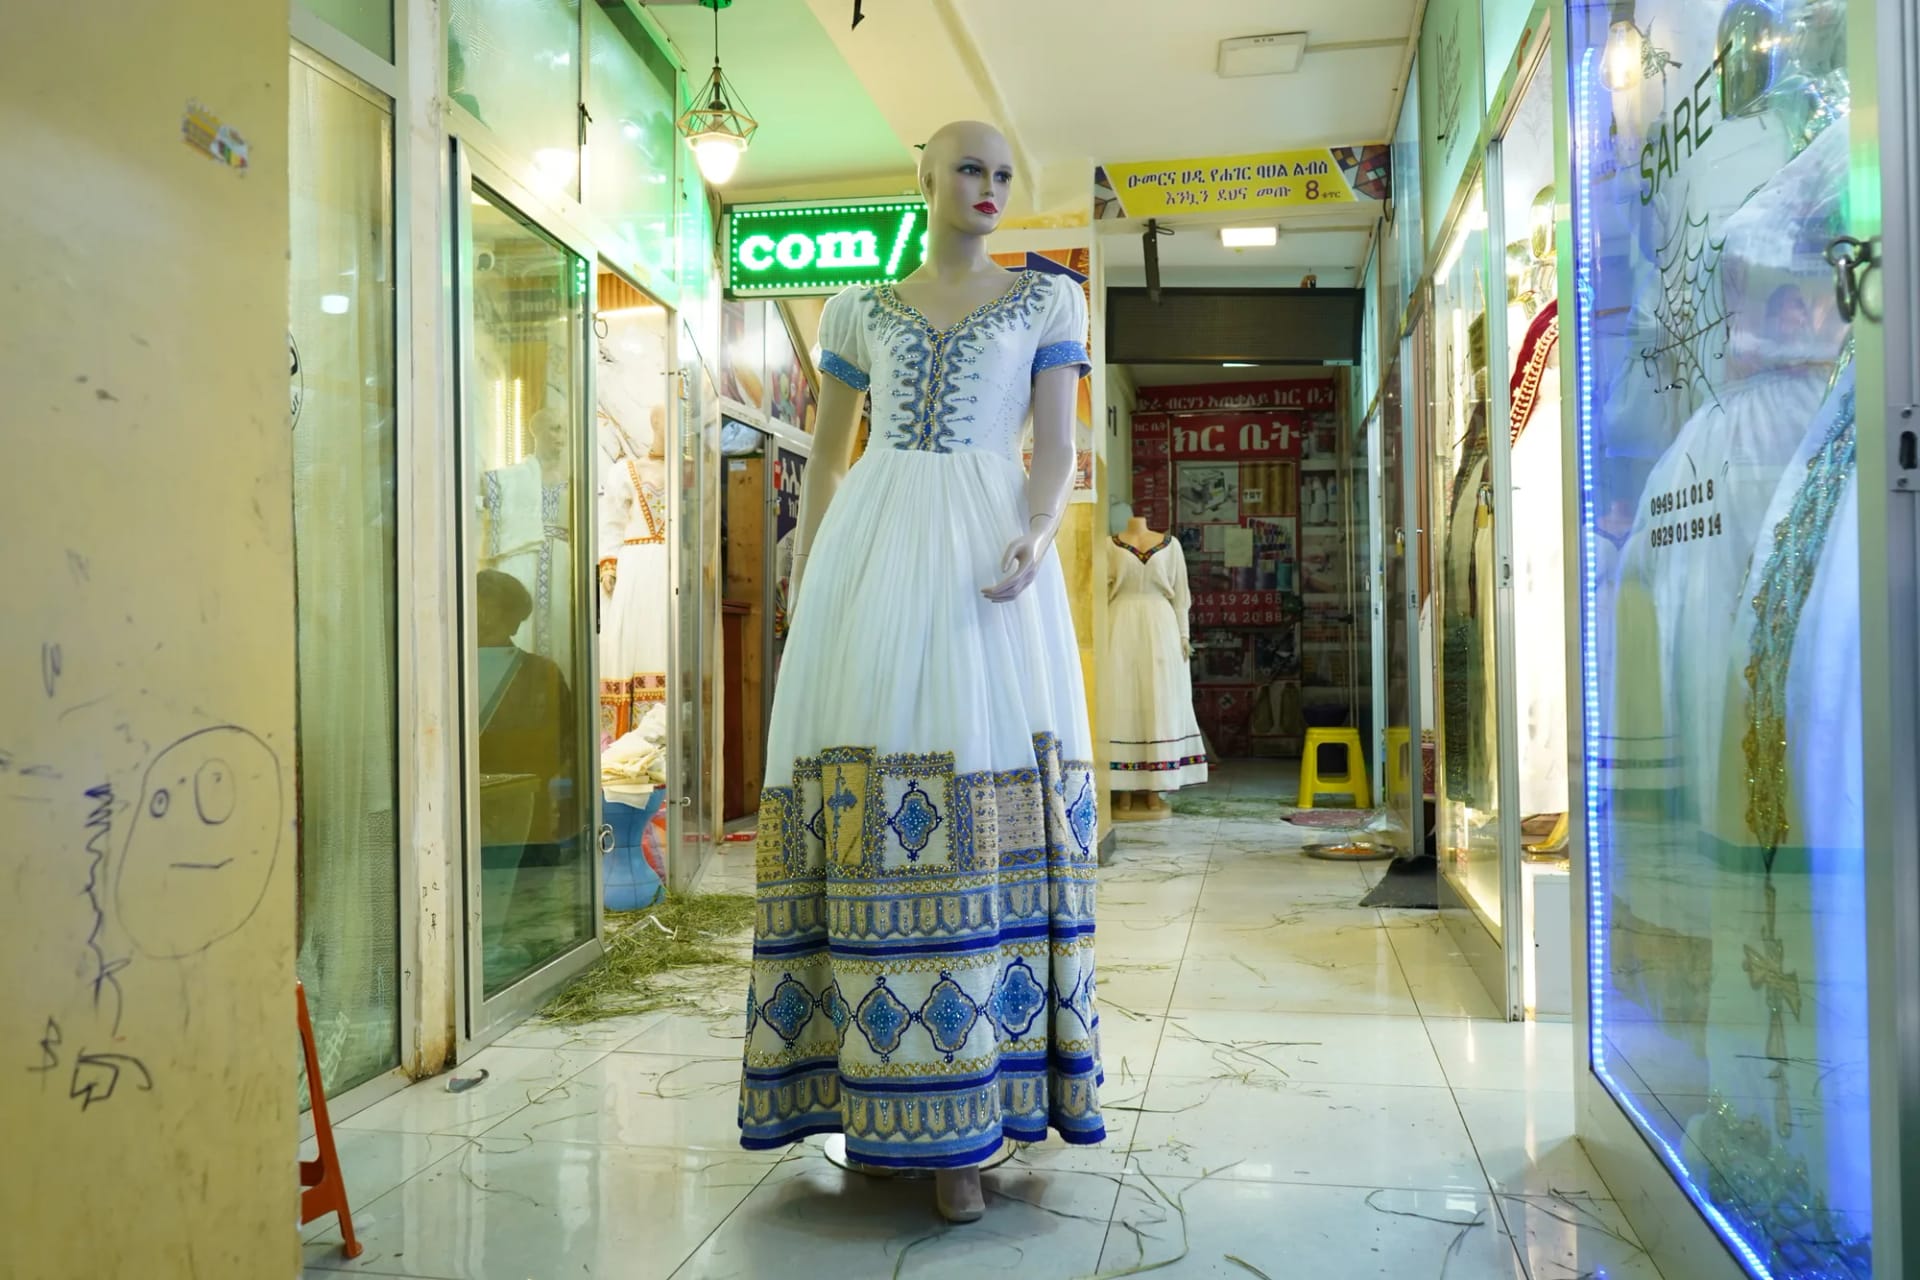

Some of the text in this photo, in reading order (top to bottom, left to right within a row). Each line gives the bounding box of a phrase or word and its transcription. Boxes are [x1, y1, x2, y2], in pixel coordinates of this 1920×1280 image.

[1640, 41, 1733, 207] SARET
[1305, 180, 1319, 200] 8
[1239, 421, 1301, 450] ቤት
[1651, 492, 1673, 517] 0949
[1676, 488, 1687, 509] 11
[1690, 482, 1703, 505] 01
[1651, 512, 1722, 548] 0929 01 99 14
[1219, 593, 1237, 605] 19
[1242, 593, 1259, 605] 24
